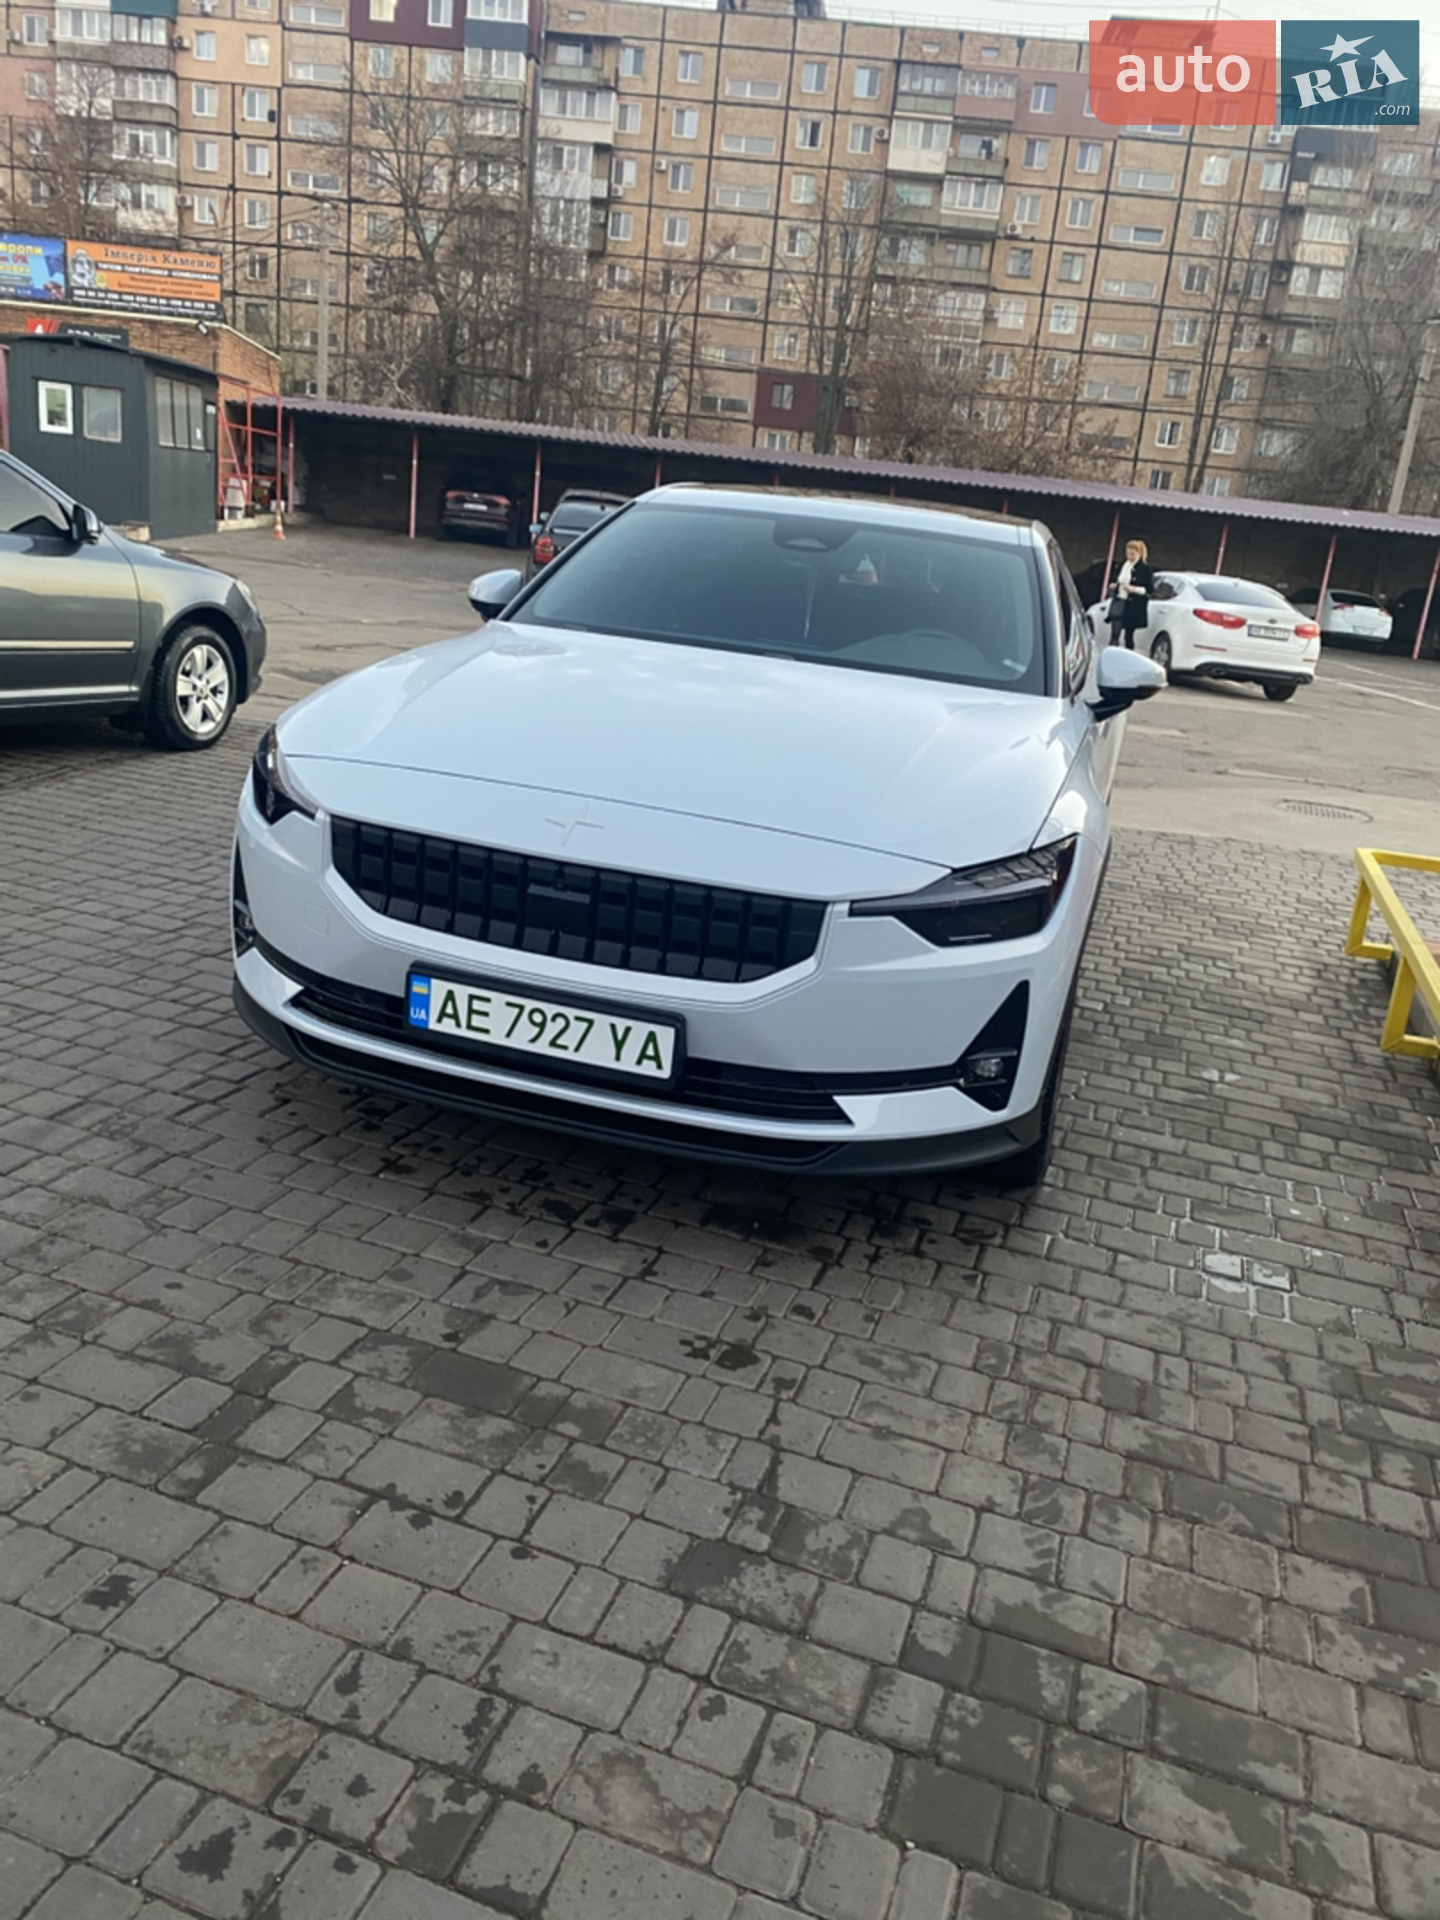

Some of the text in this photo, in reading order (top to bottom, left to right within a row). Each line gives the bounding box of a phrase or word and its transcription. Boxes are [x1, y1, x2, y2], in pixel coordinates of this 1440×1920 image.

[410, 1006, 427, 1021] UA
[436, 989, 664, 1070] AE 7927 YA
